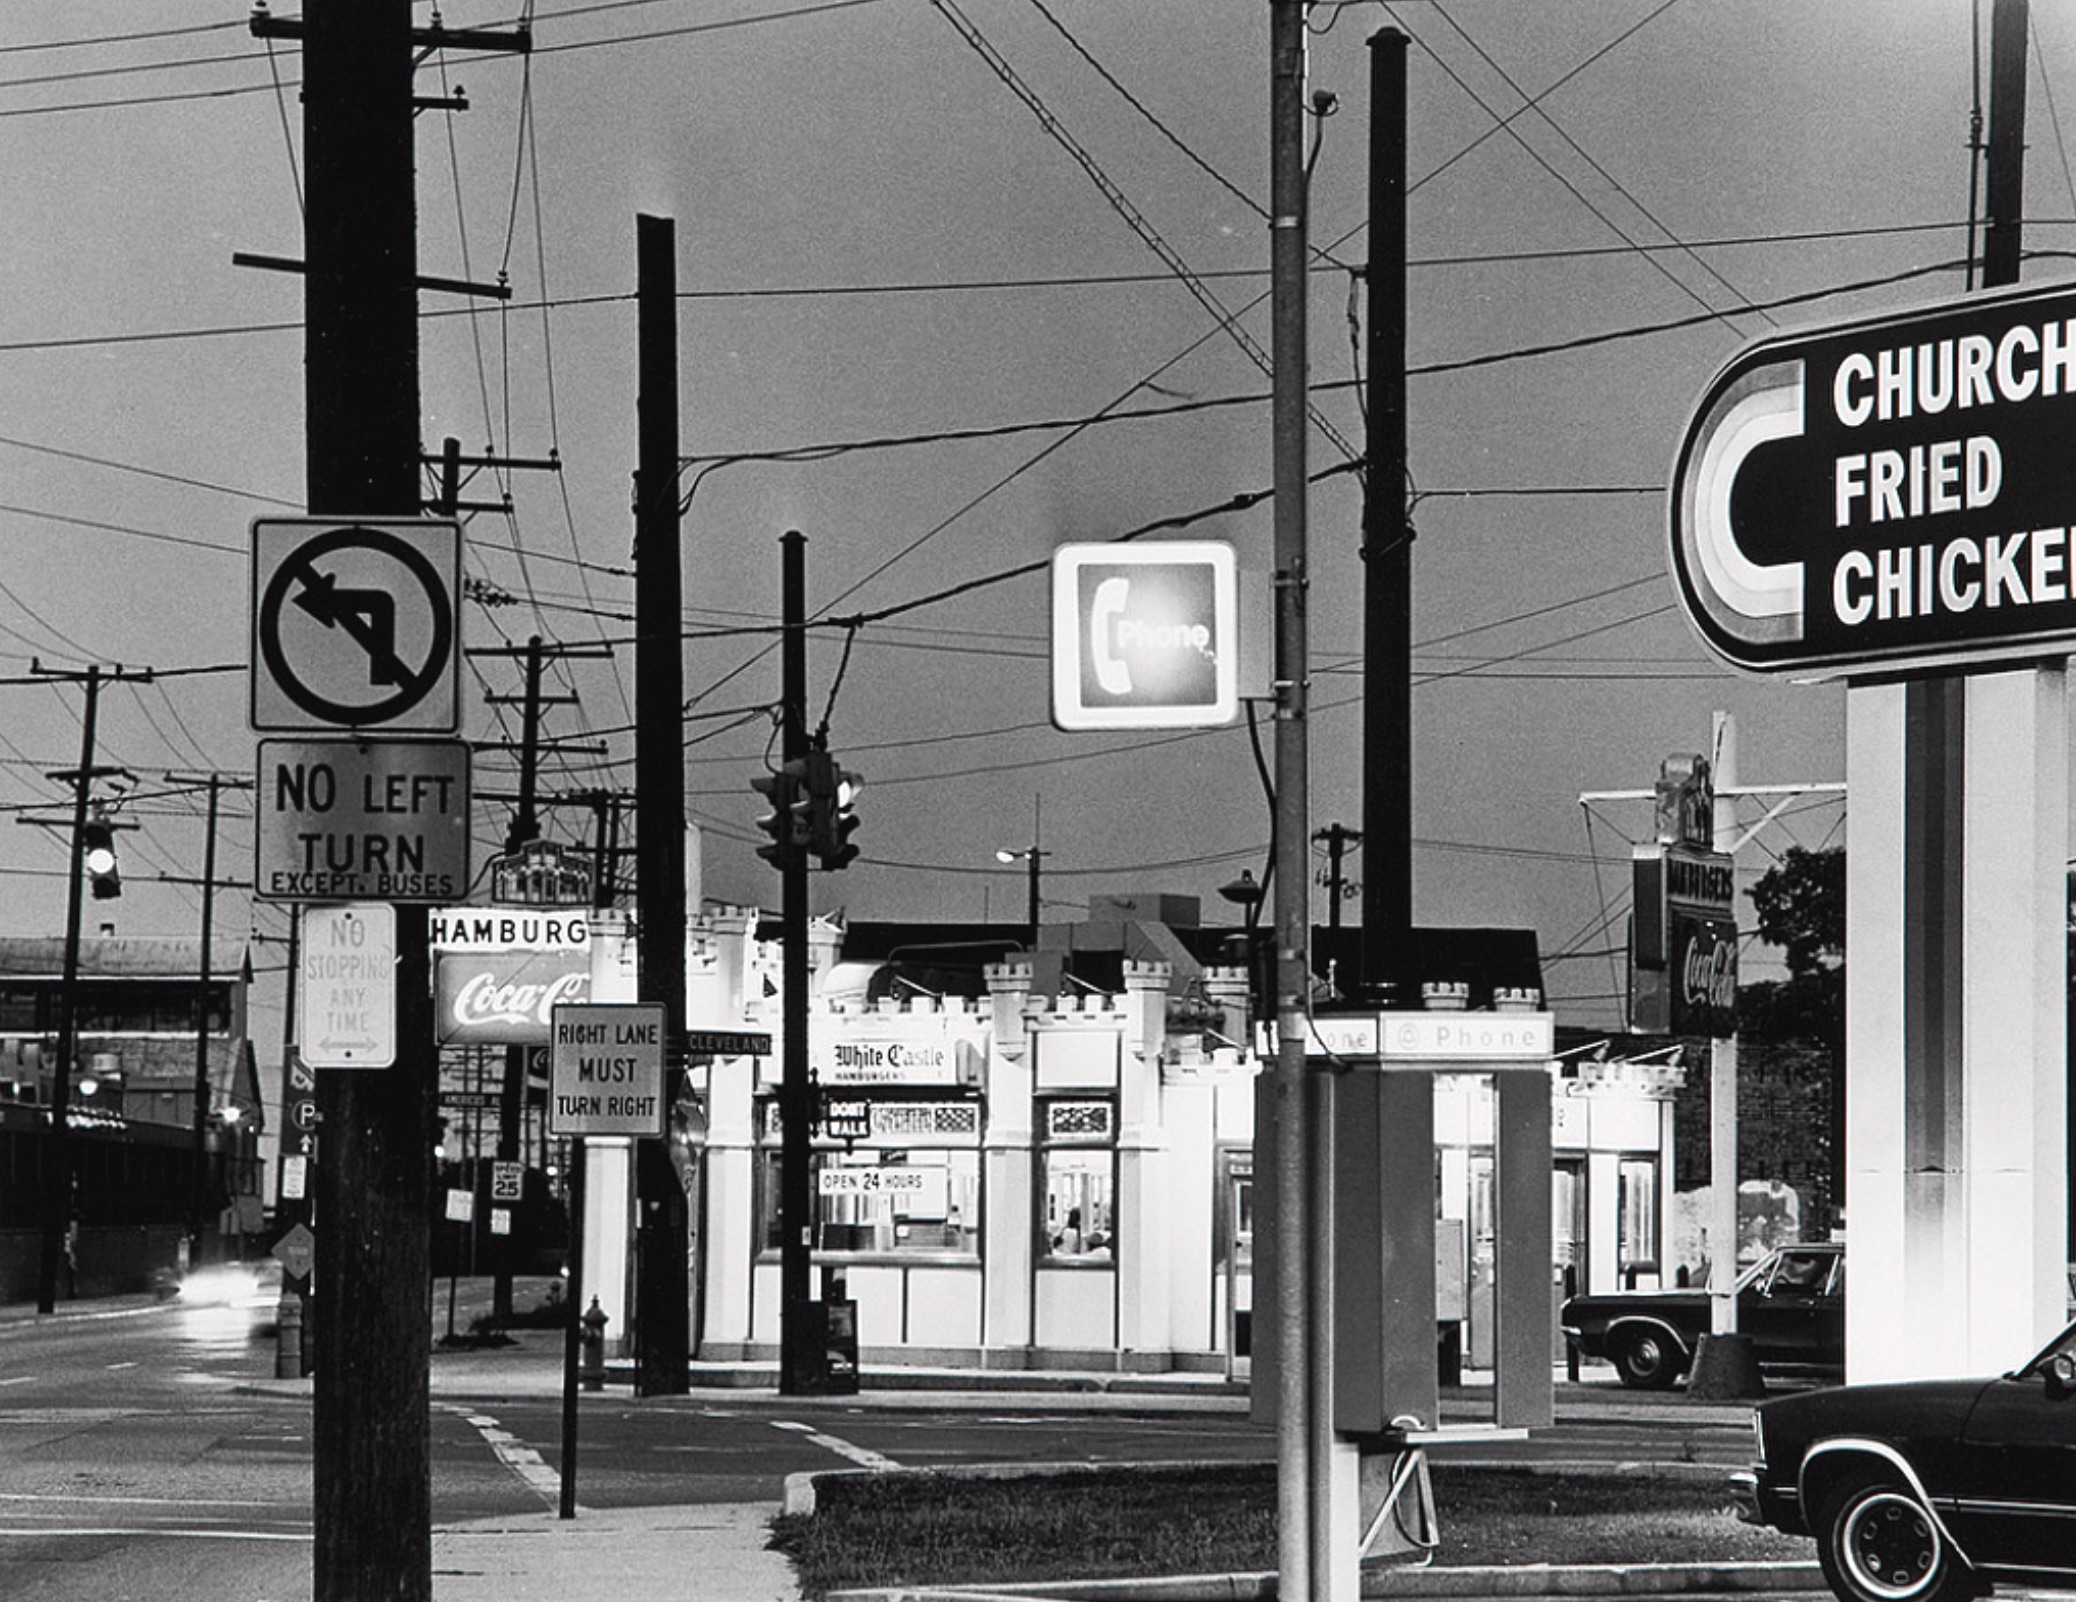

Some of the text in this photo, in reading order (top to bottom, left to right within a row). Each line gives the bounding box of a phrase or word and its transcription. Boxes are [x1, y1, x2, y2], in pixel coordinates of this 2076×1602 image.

[1834, 318, 2076, 428] CHURCH
[1836, 435, 2003, 528] FRIED
[1117, 619, 1211, 648] Phone
[276, 763, 455, 815] NO LEFT
[298, 833, 424, 873] TURN
[377, 873, 454, 895] BUSES
[330, 918, 365, 948] NO
[431, 918, 587, 944] HAMBURG
[330, 988, 366, 1008] ANY
[453, 972, 590, 1026] Coca-C
[326, 1011, 370, 1032] TIME
[558, 1024, 658, 1045] RIGHT LANE
[689, 1034, 769, 1053] CLEVELAND
[1436, 1026, 1536, 1047] Phone
[834, 1044, 945, 1069] White Castle
[578, 1057, 638, 1083] MUST
[557, 1096, 657, 1117] TURN RIGHT
[829, 1120, 869, 1137] WALK
[495, 1180, 519, 1197] 25
[823, 1172, 923, 1191] OPEN 24 HOURS
